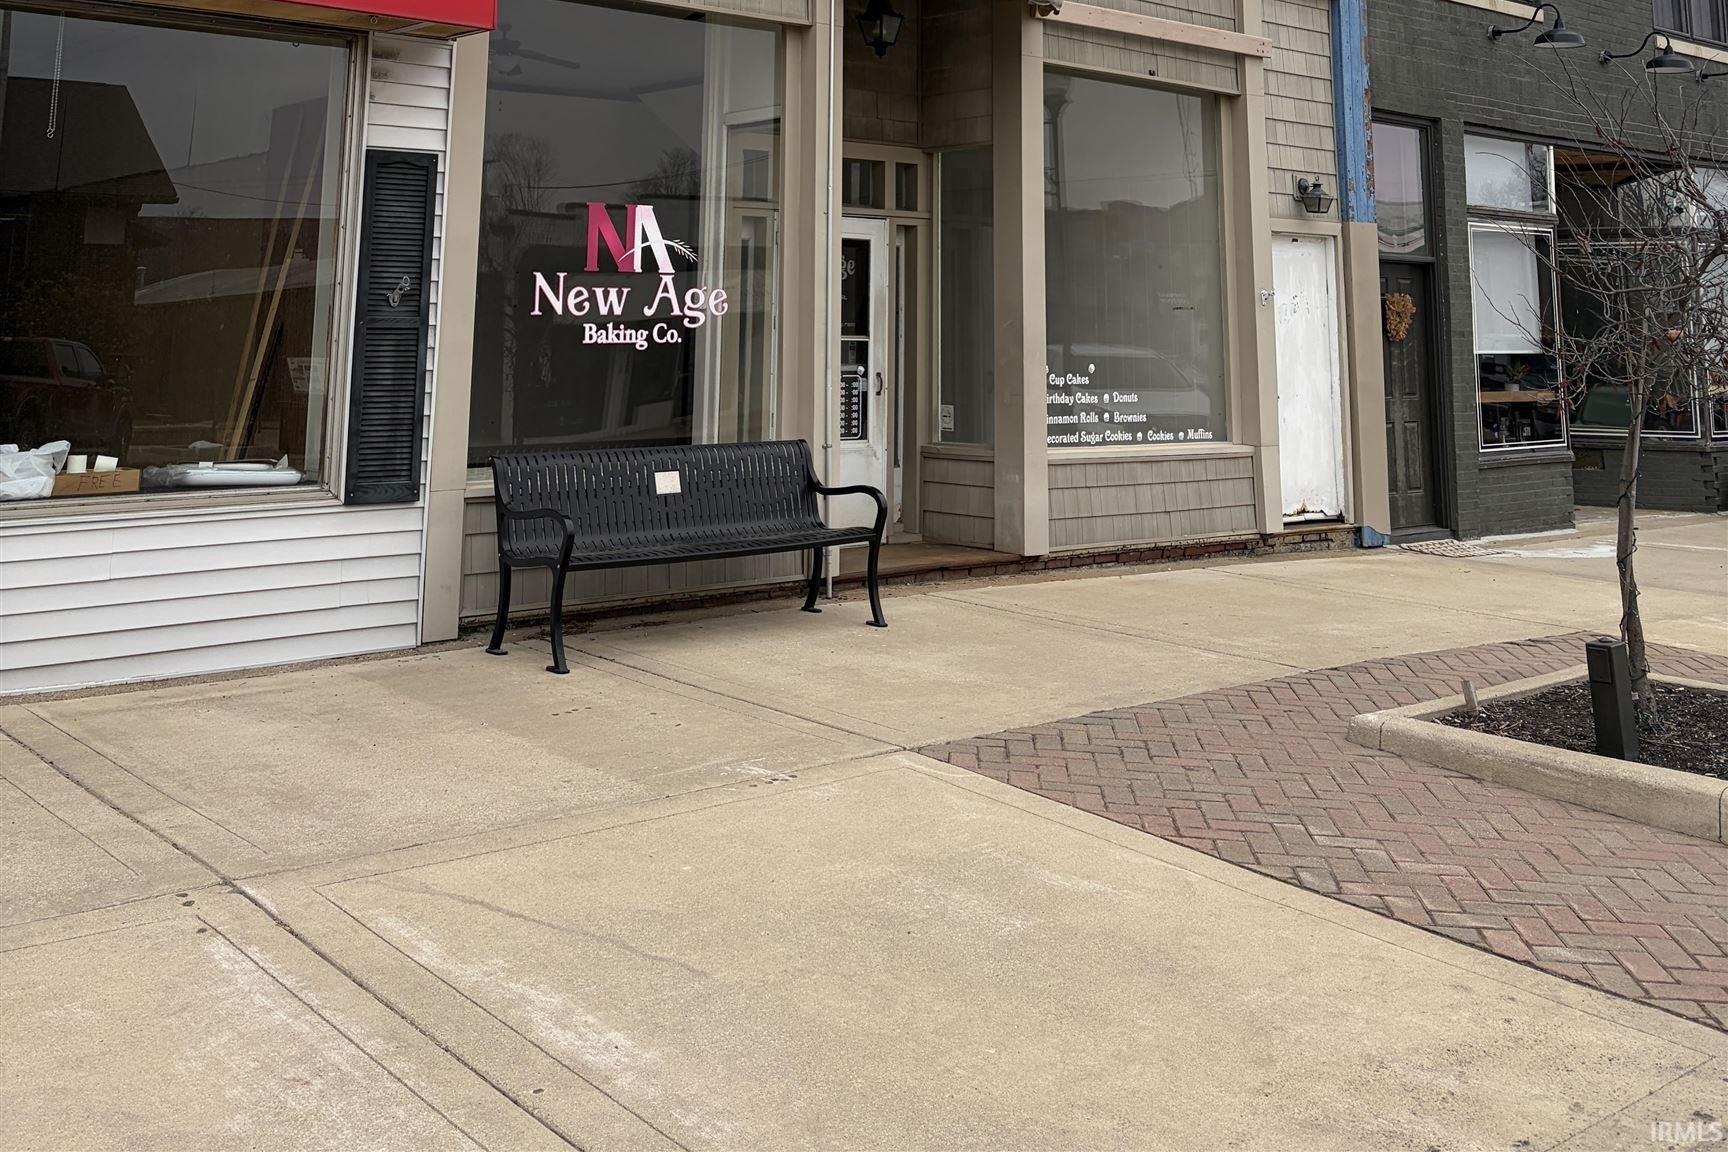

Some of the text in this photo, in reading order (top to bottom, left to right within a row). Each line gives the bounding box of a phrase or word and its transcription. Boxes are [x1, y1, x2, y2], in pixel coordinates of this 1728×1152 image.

[584, 202, 676, 273] NA
[530, 271, 728, 328] New Age
[582, 322, 682, 350] Baking Co.
[1049, 374, 1089, 387] Cup Cakes
[1046, 392, 1098, 405] irthday Cakes
[1113, 391, 1138, 403] Donuts
[1046, 411, 1099, 424] innamon Rolls
[1114, 411, 1147, 423] Brownies
[1047, 430, 1133, 445] ecorated Sugar Cookies
[1147, 429, 1174, 441] Cookies
[1187, 428, 1213, 440] Muffins
[77, 473, 121, 491] FREE
